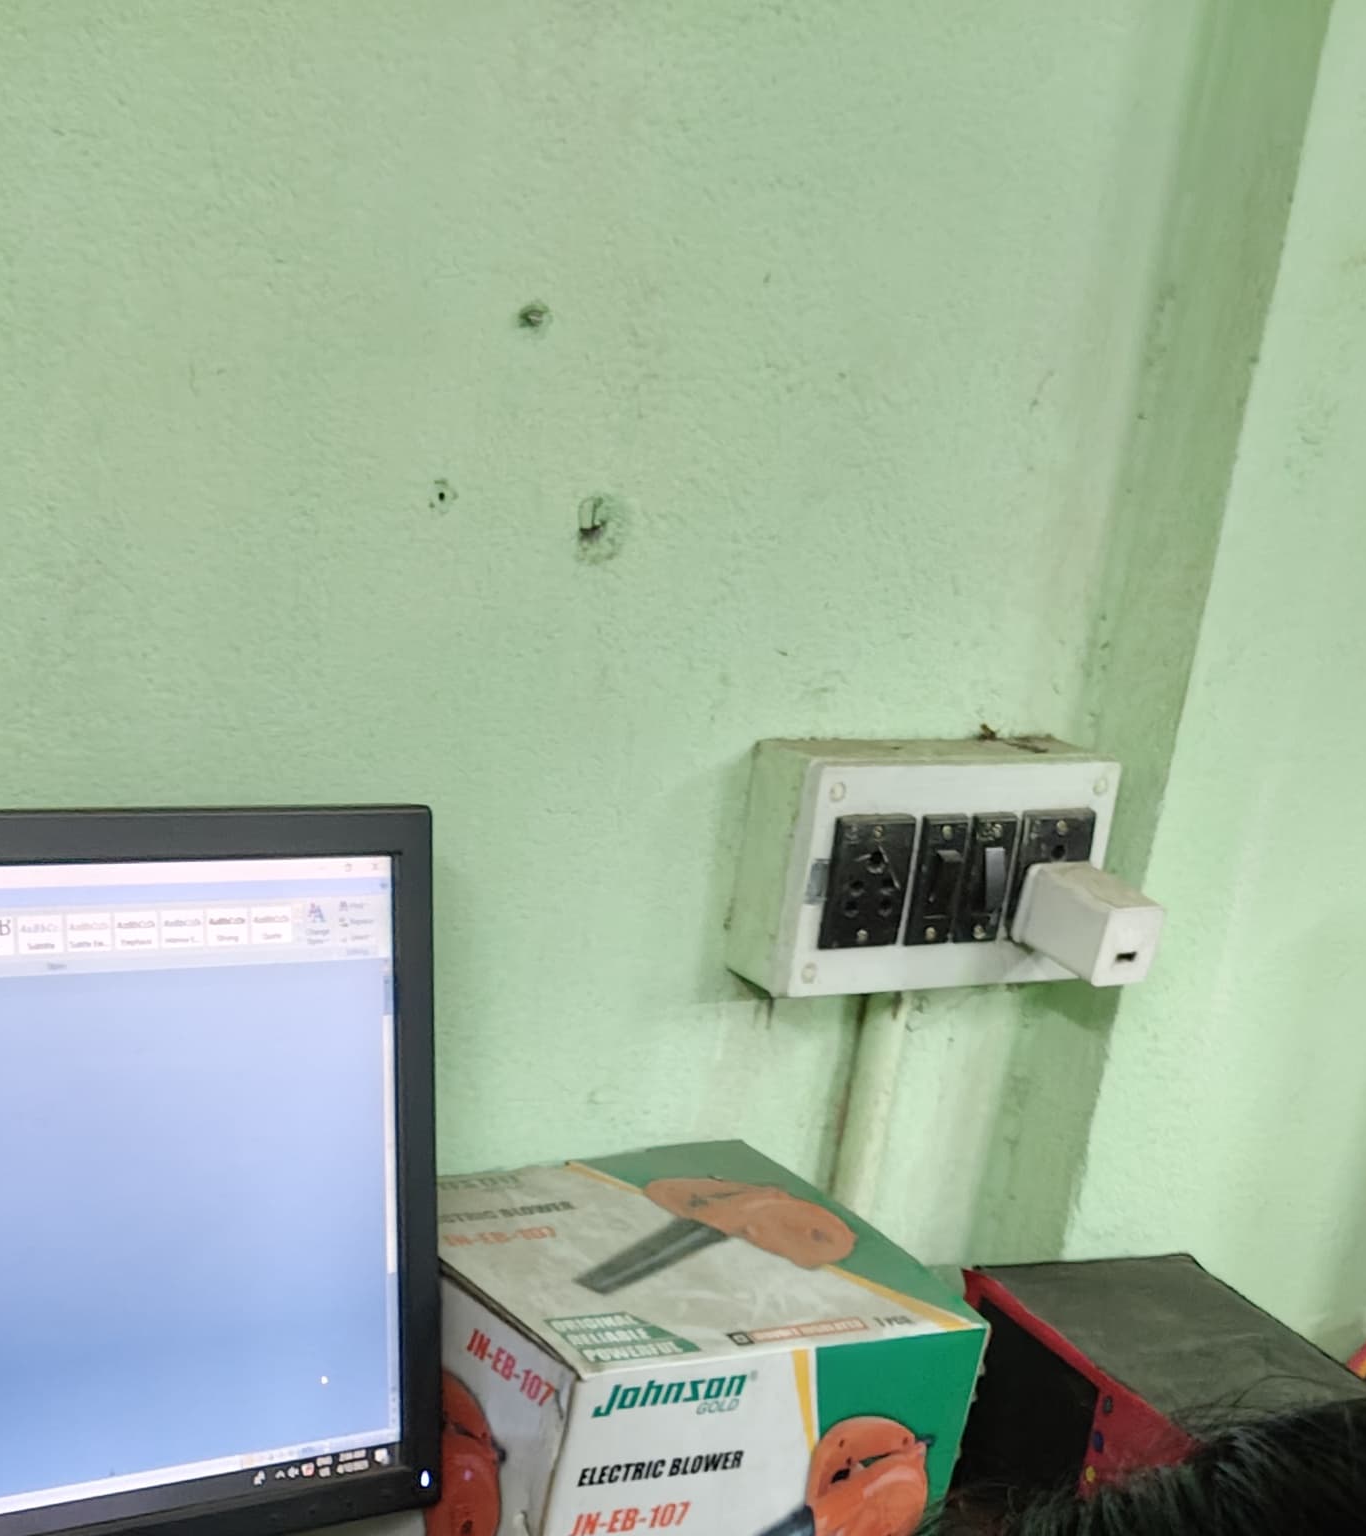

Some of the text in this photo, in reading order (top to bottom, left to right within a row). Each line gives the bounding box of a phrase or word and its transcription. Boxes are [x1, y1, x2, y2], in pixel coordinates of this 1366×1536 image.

[591, 1373, 748, 1419] Johnson
[696, 1399, 739, 1416] GOLD
[577, 1450, 744, 1487] ELECTRIC BLOWER
